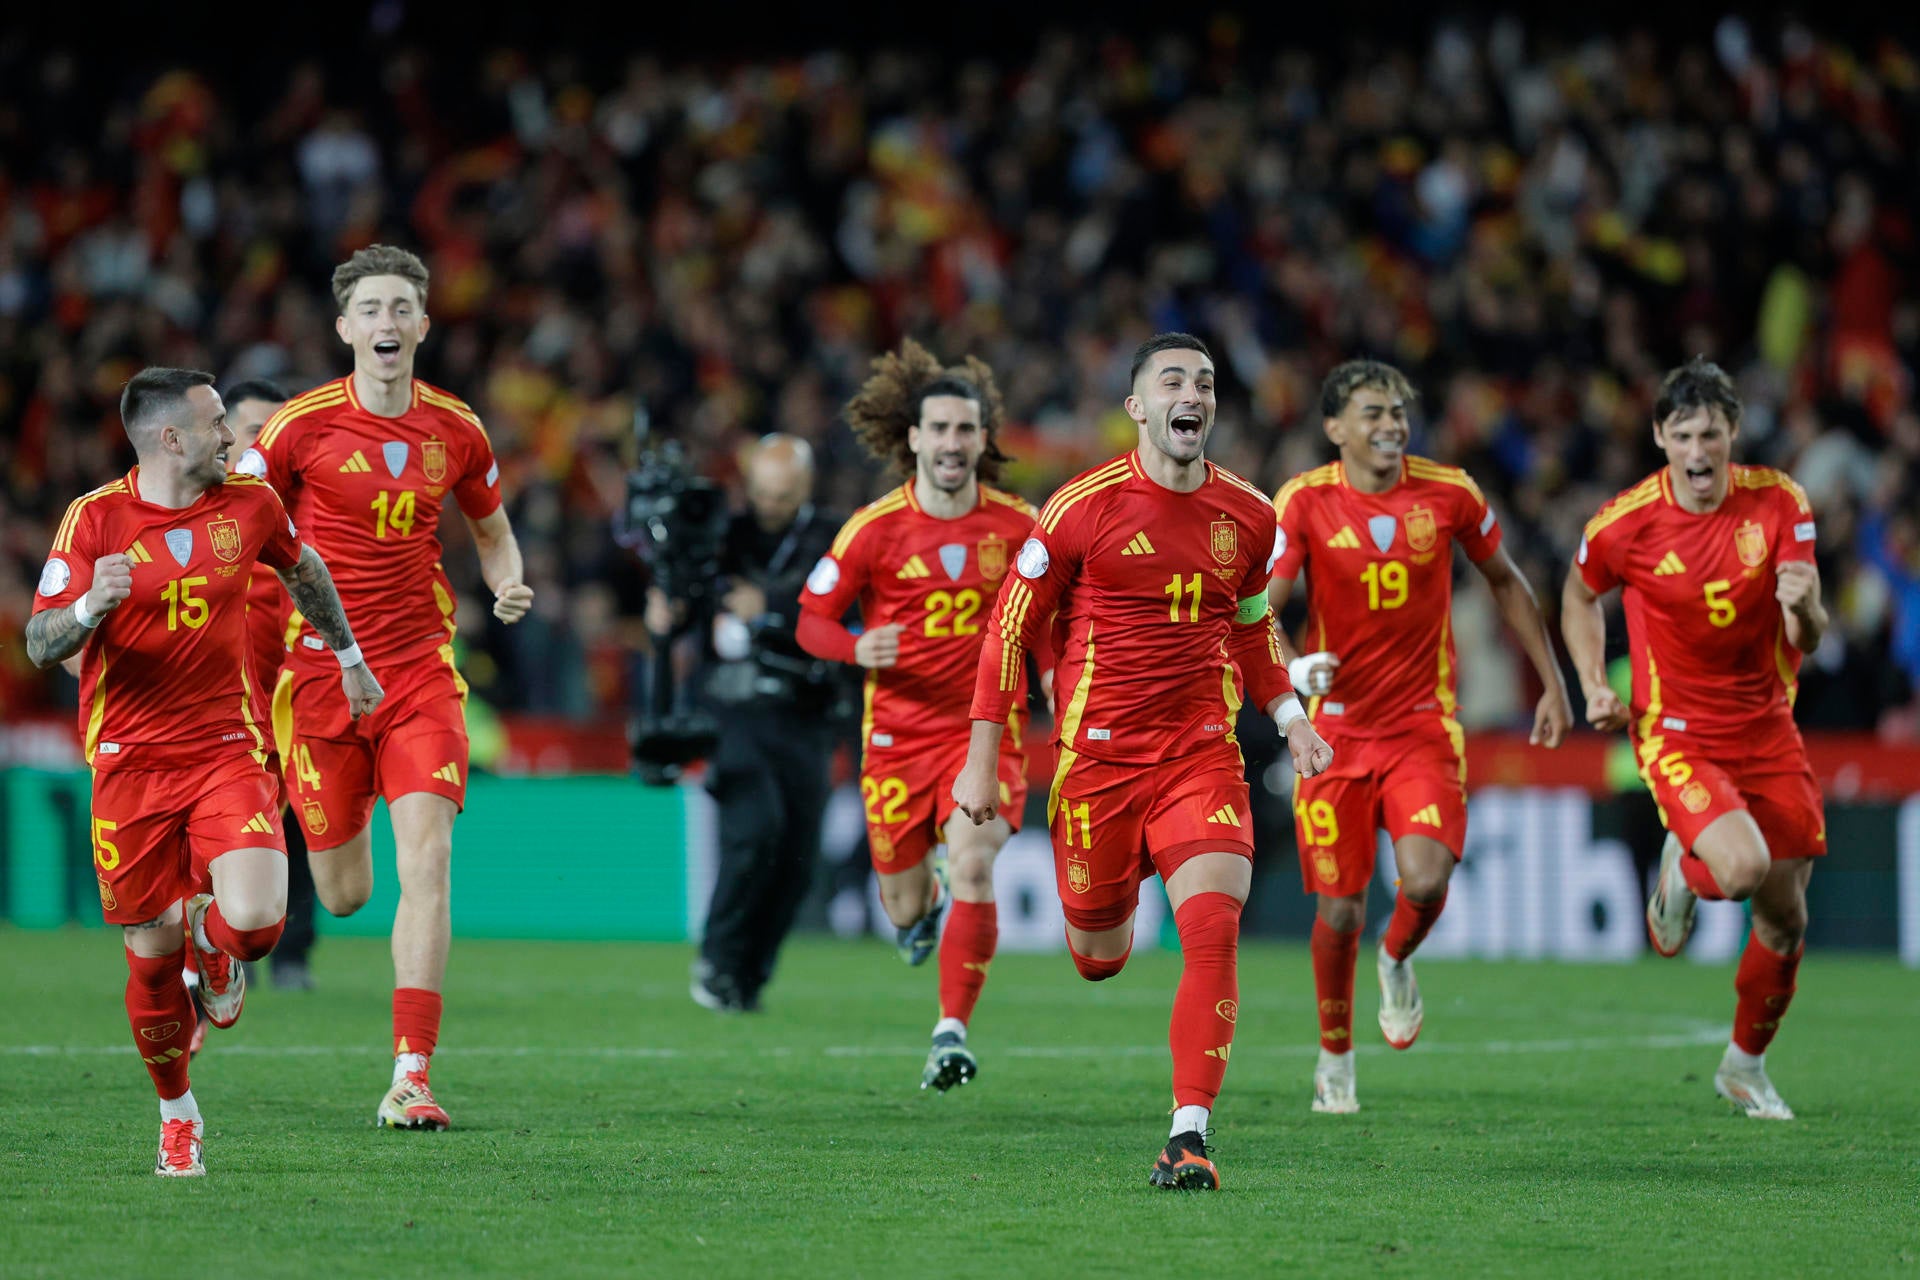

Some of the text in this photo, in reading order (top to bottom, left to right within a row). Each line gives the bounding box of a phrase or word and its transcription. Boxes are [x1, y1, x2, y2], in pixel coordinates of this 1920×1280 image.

[371, 490, 416, 539] 14
[160, 575, 209, 631] 15
[1164, 572, 1202, 623] 11
[1360, 560, 1408, 610] 19
[1703, 579, 1736, 626] 5
[924, 589, 980, 638] 22
[292, 743, 322, 794] 14
[1658, 751, 1693, 787] 5
[861, 775, 909, 825] 22
[1060, 798, 1092, 849] 11
[1295, 797, 1339, 846] 19
